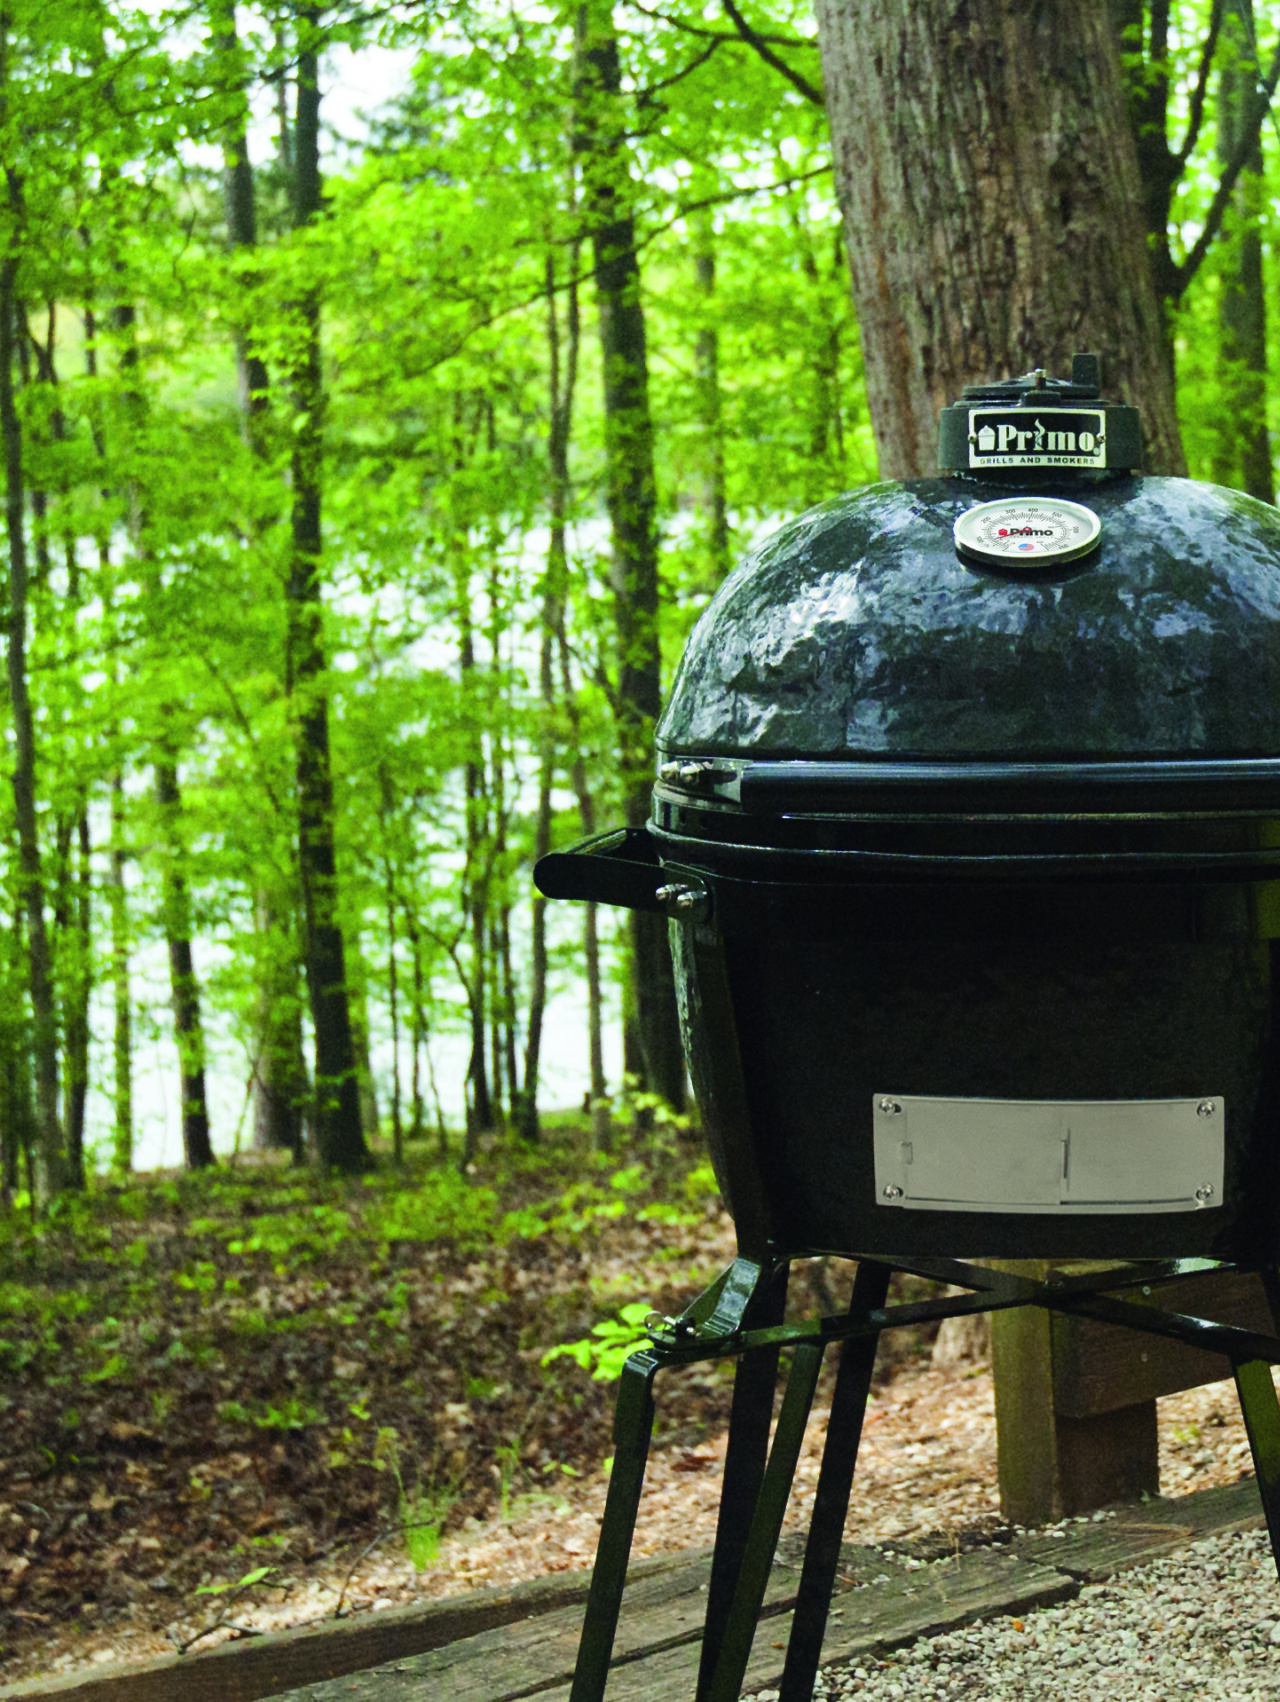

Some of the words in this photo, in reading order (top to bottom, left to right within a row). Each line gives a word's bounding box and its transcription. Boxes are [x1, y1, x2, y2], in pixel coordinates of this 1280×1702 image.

[996, 418, 1095, 452] Primo
[980, 457, 1014, 465] GRILLS
[1047, 457, 1095, 465] SMOKERS
[1009, 527, 1053, 537] Primo
